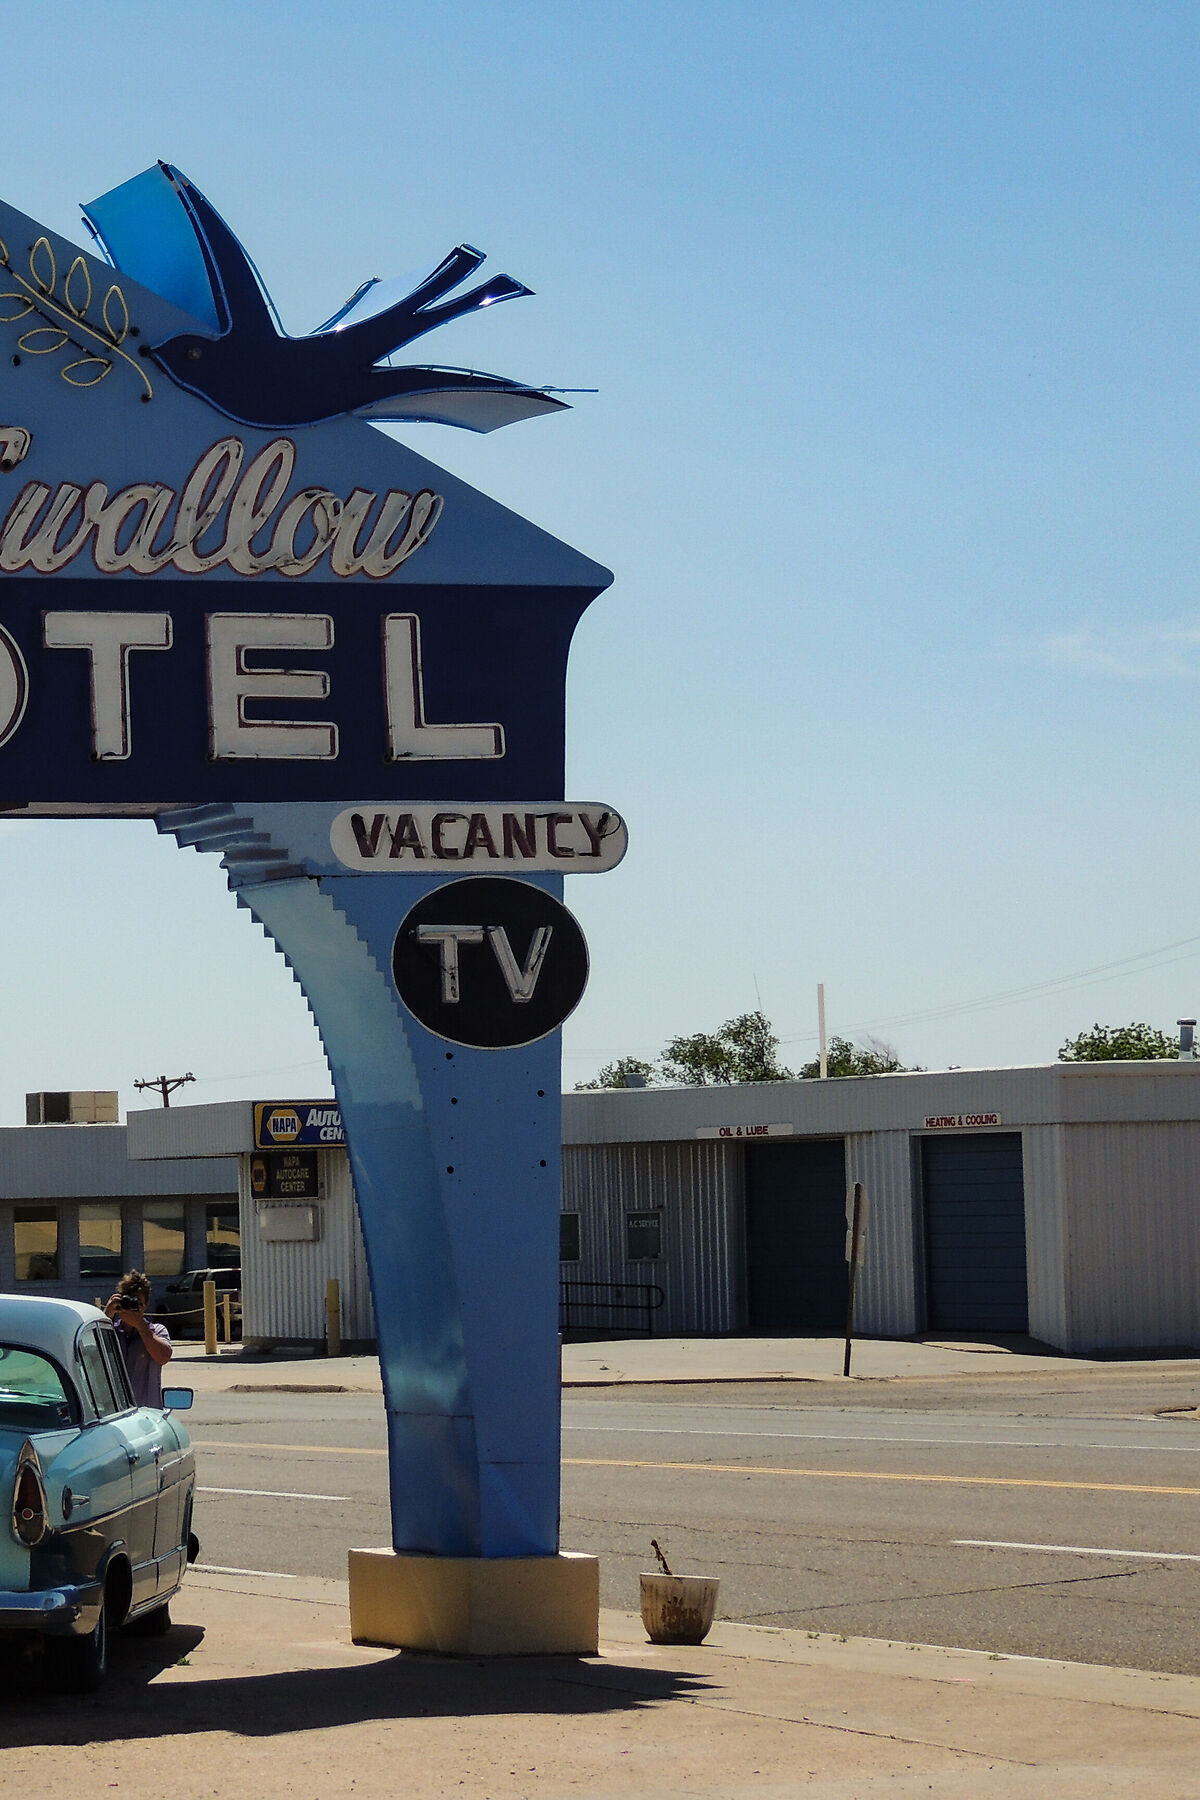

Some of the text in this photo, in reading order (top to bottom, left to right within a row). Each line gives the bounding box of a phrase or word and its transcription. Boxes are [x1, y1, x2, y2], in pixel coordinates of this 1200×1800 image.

[350, 812, 615, 859] VACANCY
[414, 924, 553, 1004] TV
[272, 1117, 297, 1133] NAPA
[925, 1114, 998, 1128] HEATING & COOLING
[718, 1125, 769, 1137] OIL & LUBE
[280, 1181, 306, 1193] CENTER
